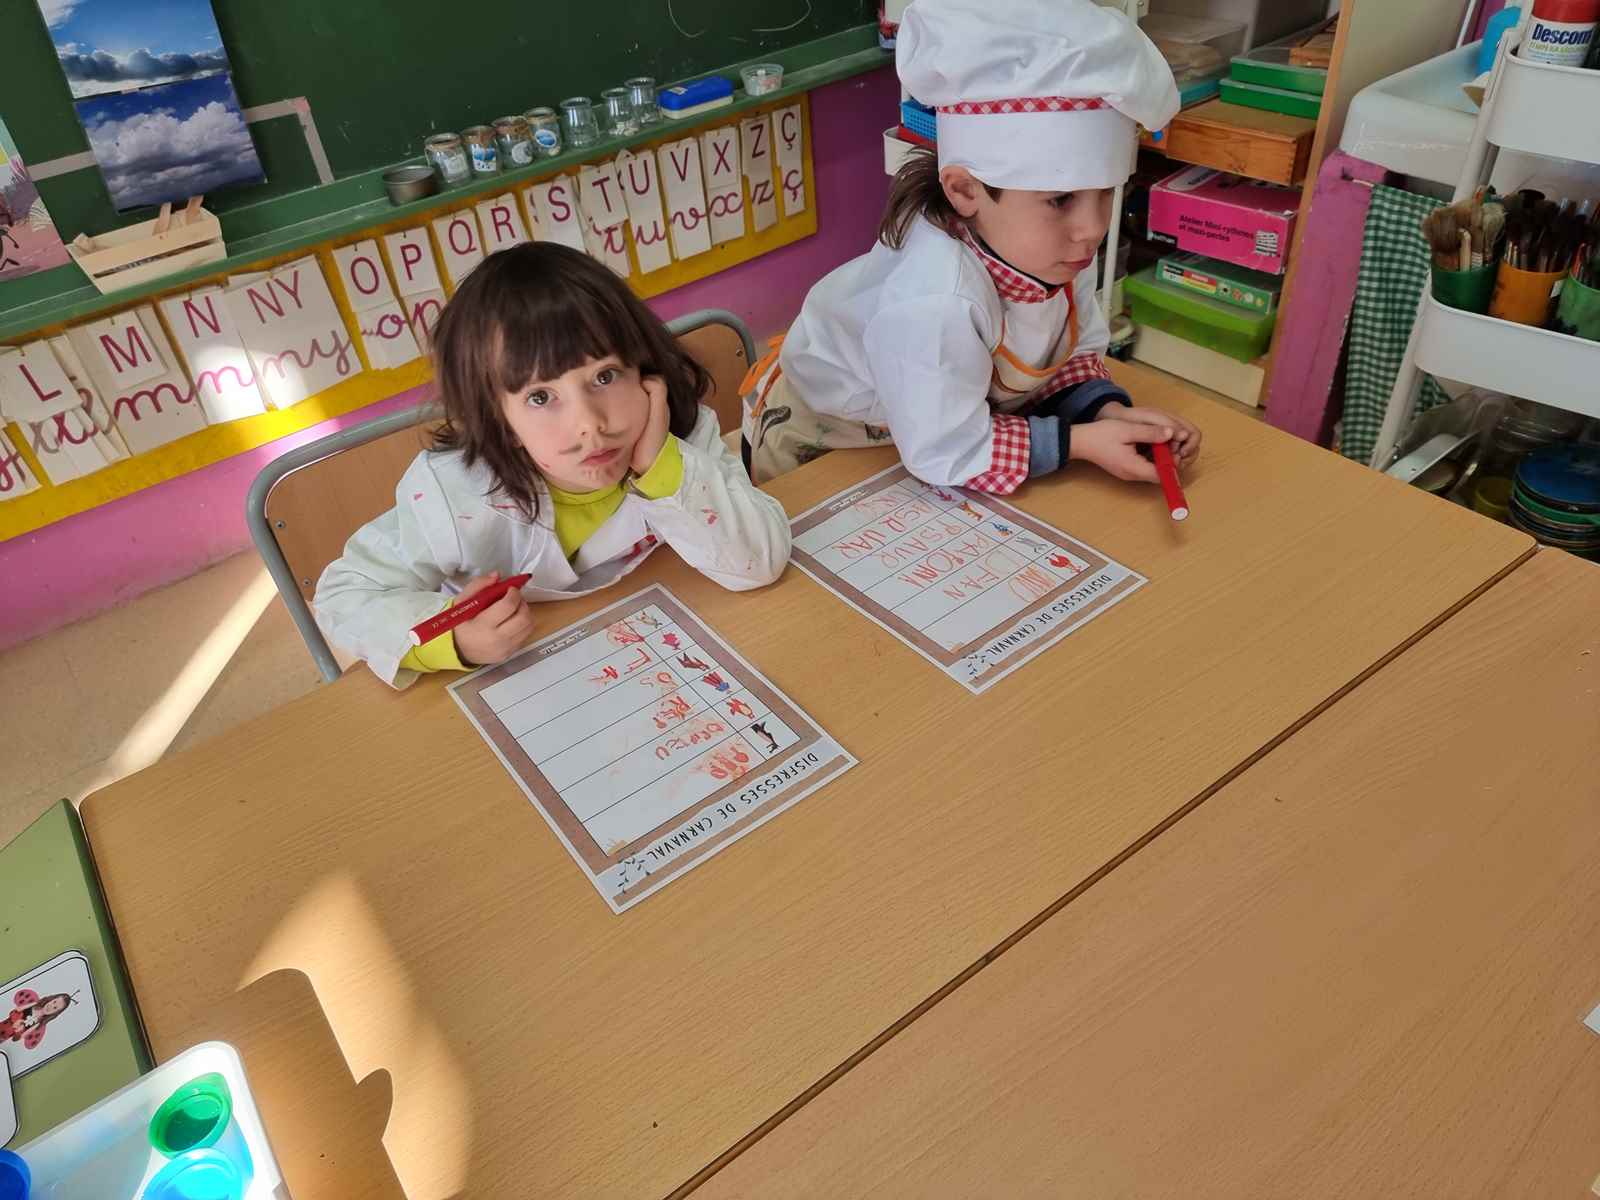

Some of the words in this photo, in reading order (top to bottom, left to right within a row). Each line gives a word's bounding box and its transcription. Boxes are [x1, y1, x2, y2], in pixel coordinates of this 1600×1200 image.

[19, 364, 62, 402] L
[99, 326, 152, 373] M
[183, 295, 221, 338] N
[246, 270, 302, 324] NY
[350, 256, 380, 295] O
[400, 243, 422, 281] P
[448, 219, 477, 255] Q
[490, 206, 516, 242] R
[548, 185, 571, 222] S
[591, 175, 612, 213] T
[628, 159, 650, 195] U
[670, 148, 689, 182] V
[713, 139, 731, 175] X
[750, 124, 766, 159] Z
[780, 111, 797, 150] Ç
[114, 382, 195, 421] m
[1052, 574, 1113, 614] DISFRESSES
[1036, 612, 1053, 624] DE
[985, 623, 1037, 655] CARNAVAL
[740, 752, 819, 804] DISFRESSES
[717, 802, 737, 819] DE
[647, 817, 713, 860] CARNAVAL
